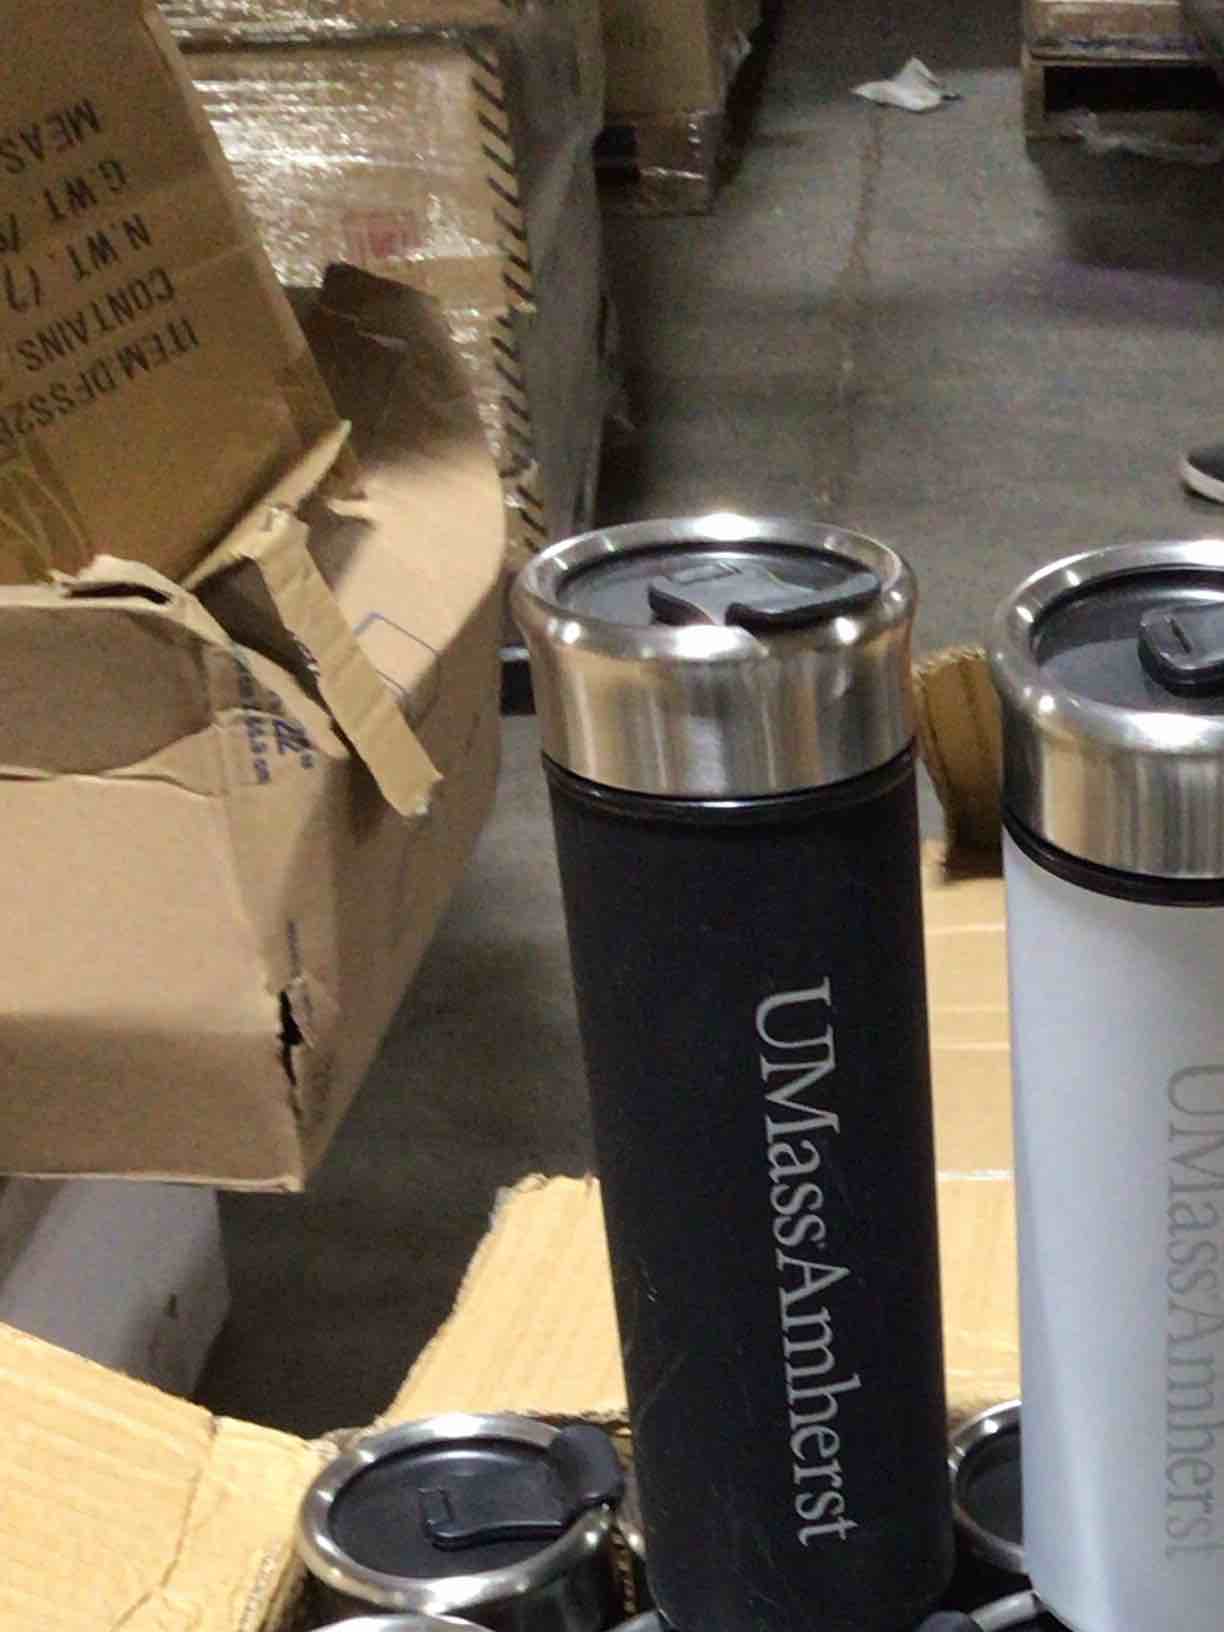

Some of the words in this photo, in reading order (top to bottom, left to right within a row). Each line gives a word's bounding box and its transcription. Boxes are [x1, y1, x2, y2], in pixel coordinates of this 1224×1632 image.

[17, 264, 175, 373] CONTAINS
[116, 314, 200, 381] ITEM
[754, 977, 862, 1548] UMassAmherst
